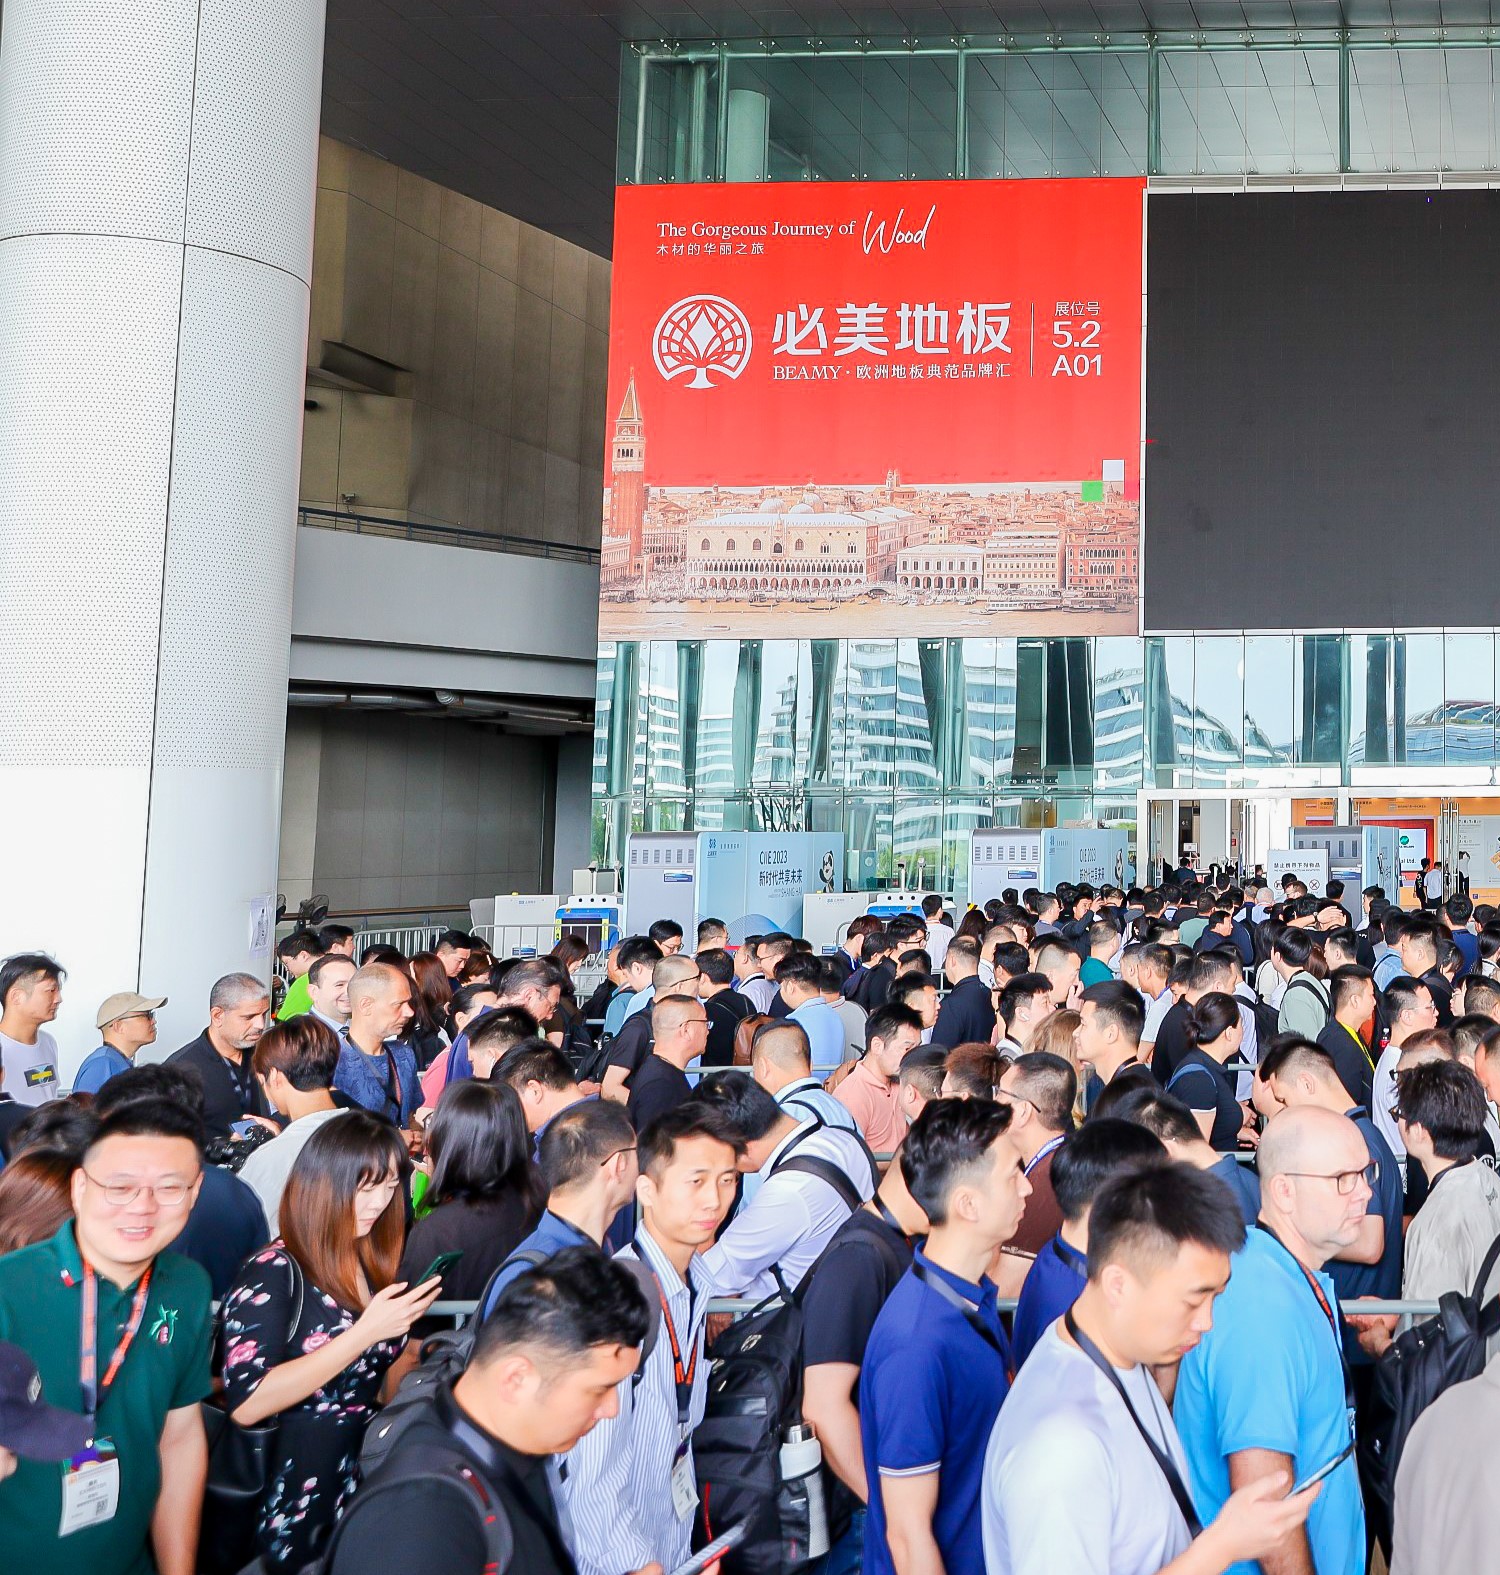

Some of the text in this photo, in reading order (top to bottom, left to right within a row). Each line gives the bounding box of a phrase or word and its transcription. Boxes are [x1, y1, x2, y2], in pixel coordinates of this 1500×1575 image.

[656, 204, 937, 256] The Gorgeous Journey of Wood
[656, 242, 765, 257] 木材的华丽之旅
[1054, 301, 1101, 317] 展位号
[771, 301, 1012, 357] 必美地板
[1052, 320, 1101, 349] 5.2
[773, 362, 1011, 381] BEAMY 欧洲地板典范品牌汇
[1051, 354, 1102, 377] A01
[773, 850, 788, 865] 2023
